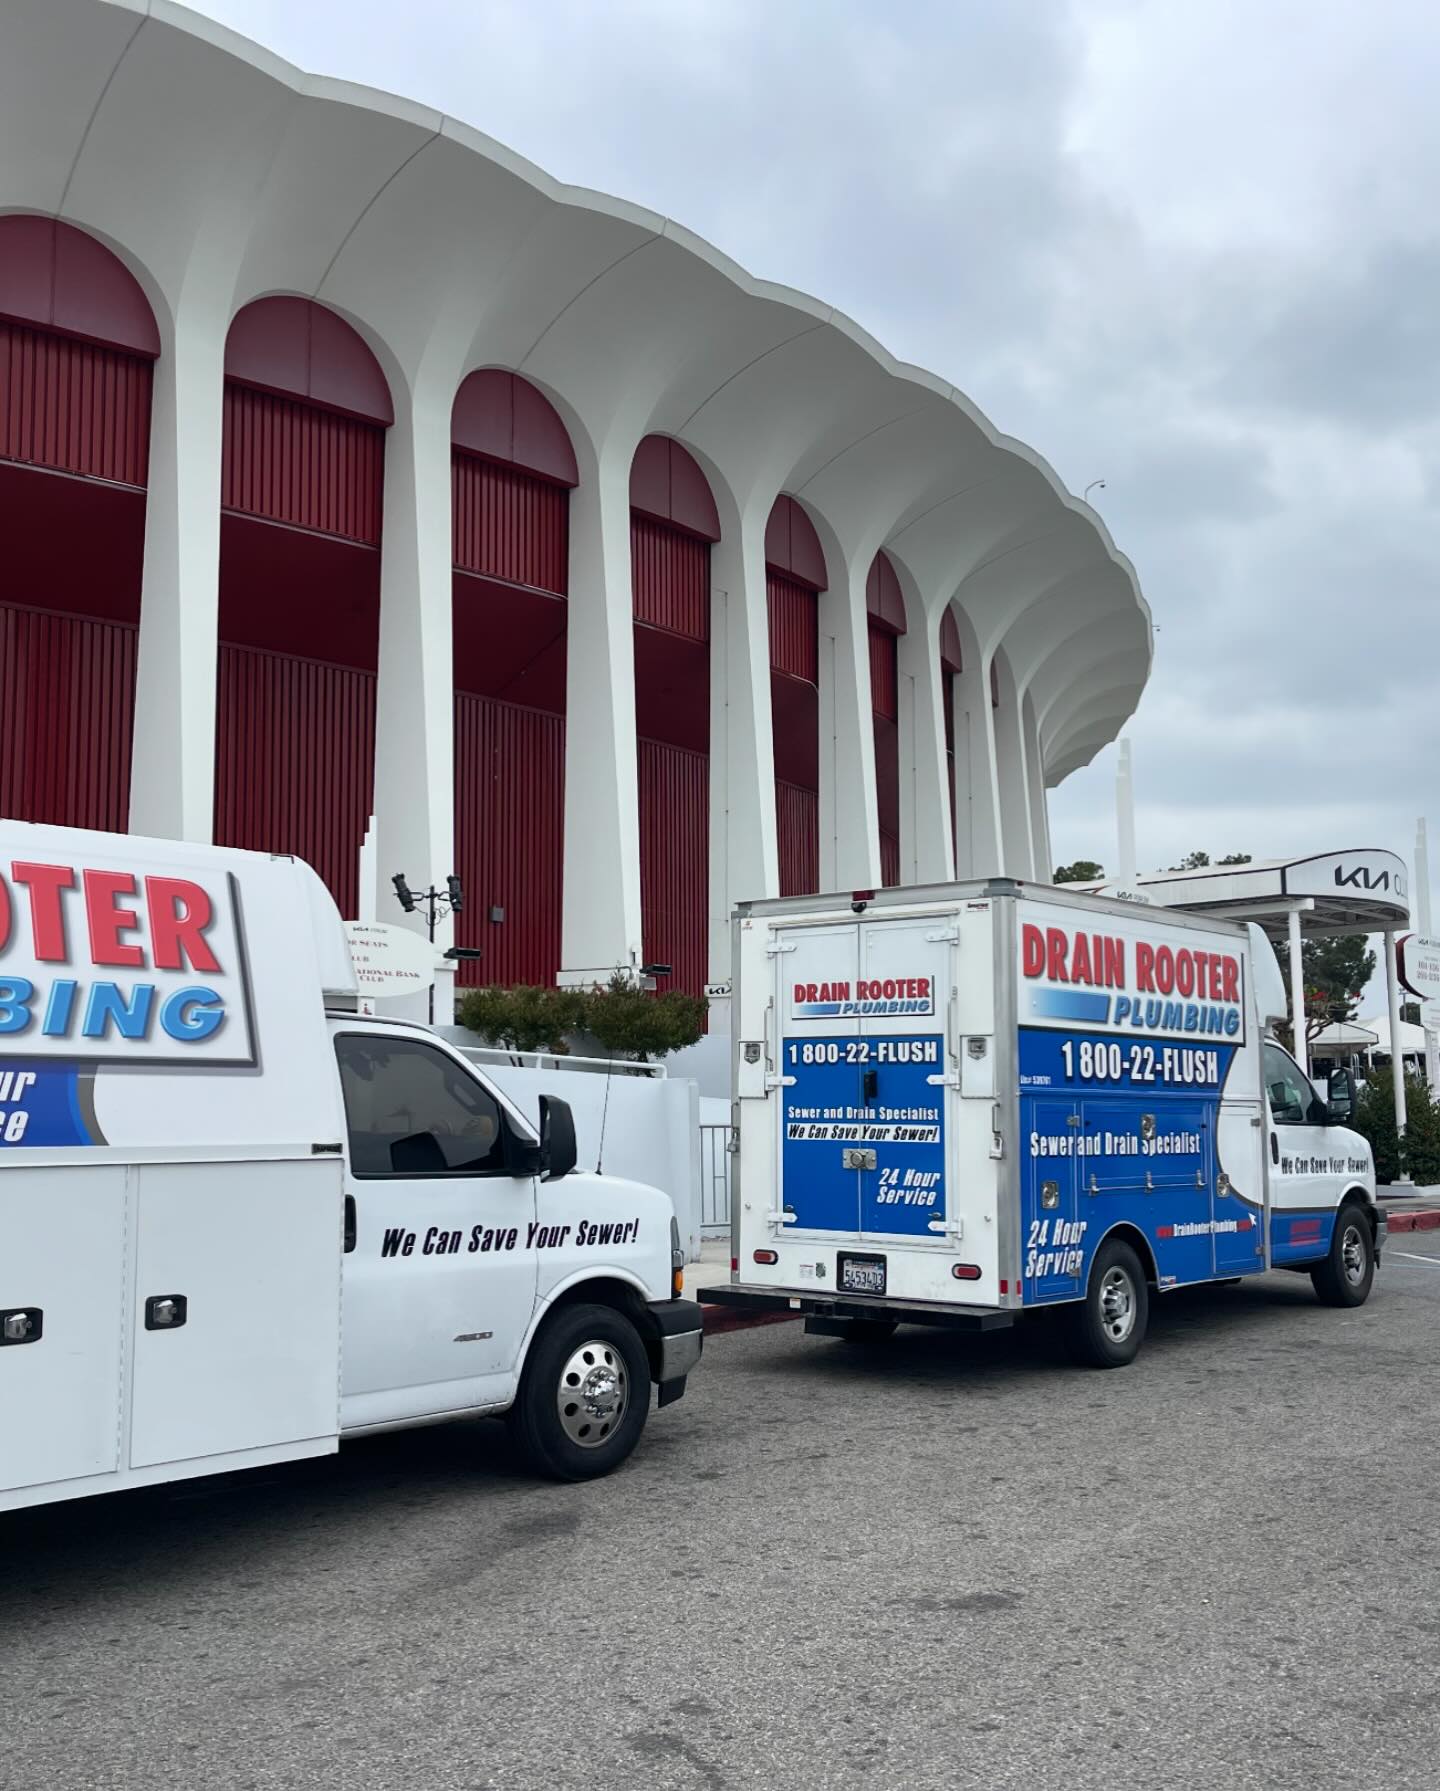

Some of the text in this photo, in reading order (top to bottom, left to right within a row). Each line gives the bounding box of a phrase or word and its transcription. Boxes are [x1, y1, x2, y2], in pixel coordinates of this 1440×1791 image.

[1334, 864, 1389, 891] KIA
[0, 860, 224, 974] TER
[1022, 923, 1240, 1003] DRAIN ROOTER
[794, 978, 931, 1004] DRAIN ROOTER
[842, 999, 931, 1015] PLUMBING
[1114, 996, 1240, 1037] PLUMBING
[802, 1041, 938, 1064] 800-22-FLUSH
[1080, 1041, 1219, 1084] 800-22-FLUSH
[788, 1106, 940, 1121] Sewer and Drain Specialist
[789, 1125, 938, 1142] We Can Save Your Sewer!
[1030, 1131, 1201, 1157] Sewer and Drain Specialist
[878, 1168, 941, 1188] 24 Hour
[1281, 1156, 1293, 1175] We
[1295, 1156, 1308, 1174] Can
[1310, 1156, 1327, 1174] Save
[1329, 1156, 1345, 1174] Your
[877, 1187, 937, 1206] Service
[381, 1217, 640, 1258] We Can Save Your Sewer!
[1027, 1218, 1087, 1249] 24 Hour
[1025, 1248, 1084, 1279] Service
